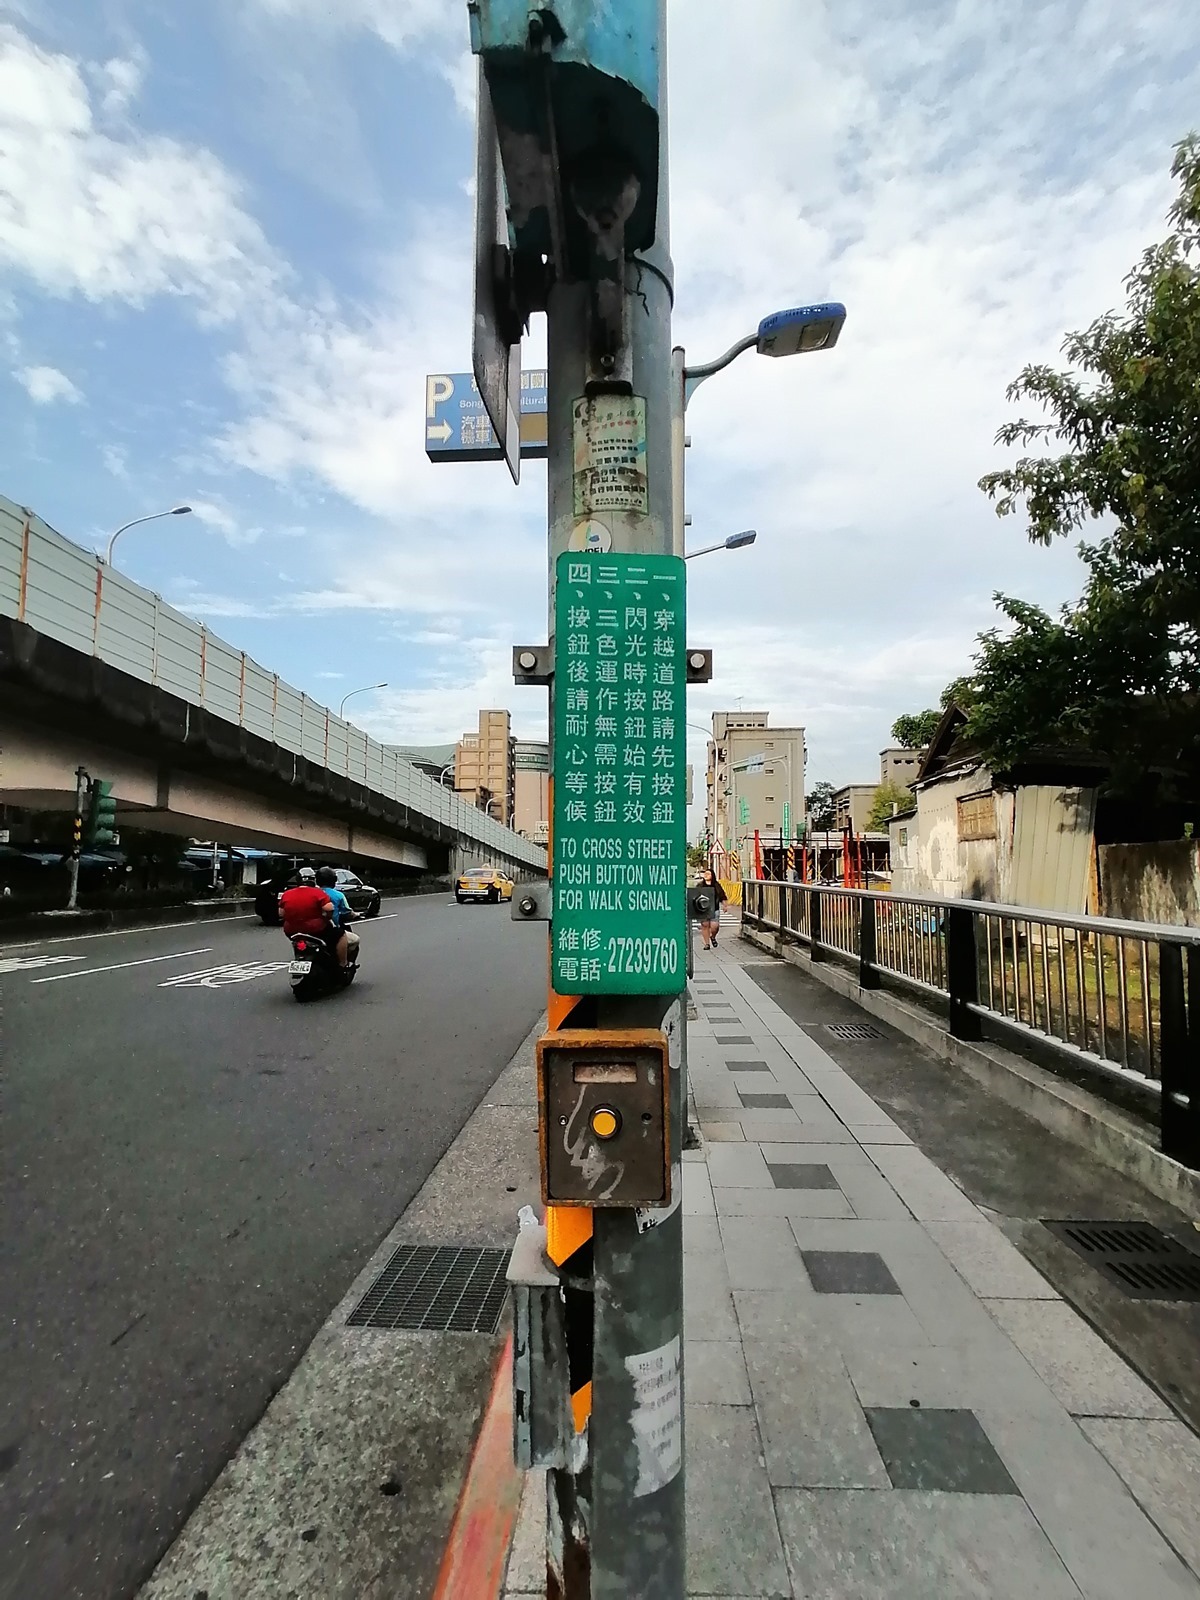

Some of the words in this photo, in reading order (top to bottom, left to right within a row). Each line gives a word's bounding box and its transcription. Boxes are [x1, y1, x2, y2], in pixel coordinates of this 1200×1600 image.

[427, 375, 454, 418] P
[459, 399, 483, 409] Song
[521, 395, 547, 406] ltural
[461, 415, 490, 430] 汽車
[560, 837, 577, 858] TO
[582, 838, 622, 859] CROSS
[627, 838, 673, 859] STREET
[559, 863, 591, 885] PUSH
[596, 864, 643, 885] BUTTON
[649, 864, 678, 885] WAIT
[558, 889, 583, 910] FOR
[588, 890, 623, 911] WALK
[628, 890, 672, 911] SIGNAL
[558, 927, 602, 951] 維修
[557, 957, 602, 982] 電話
